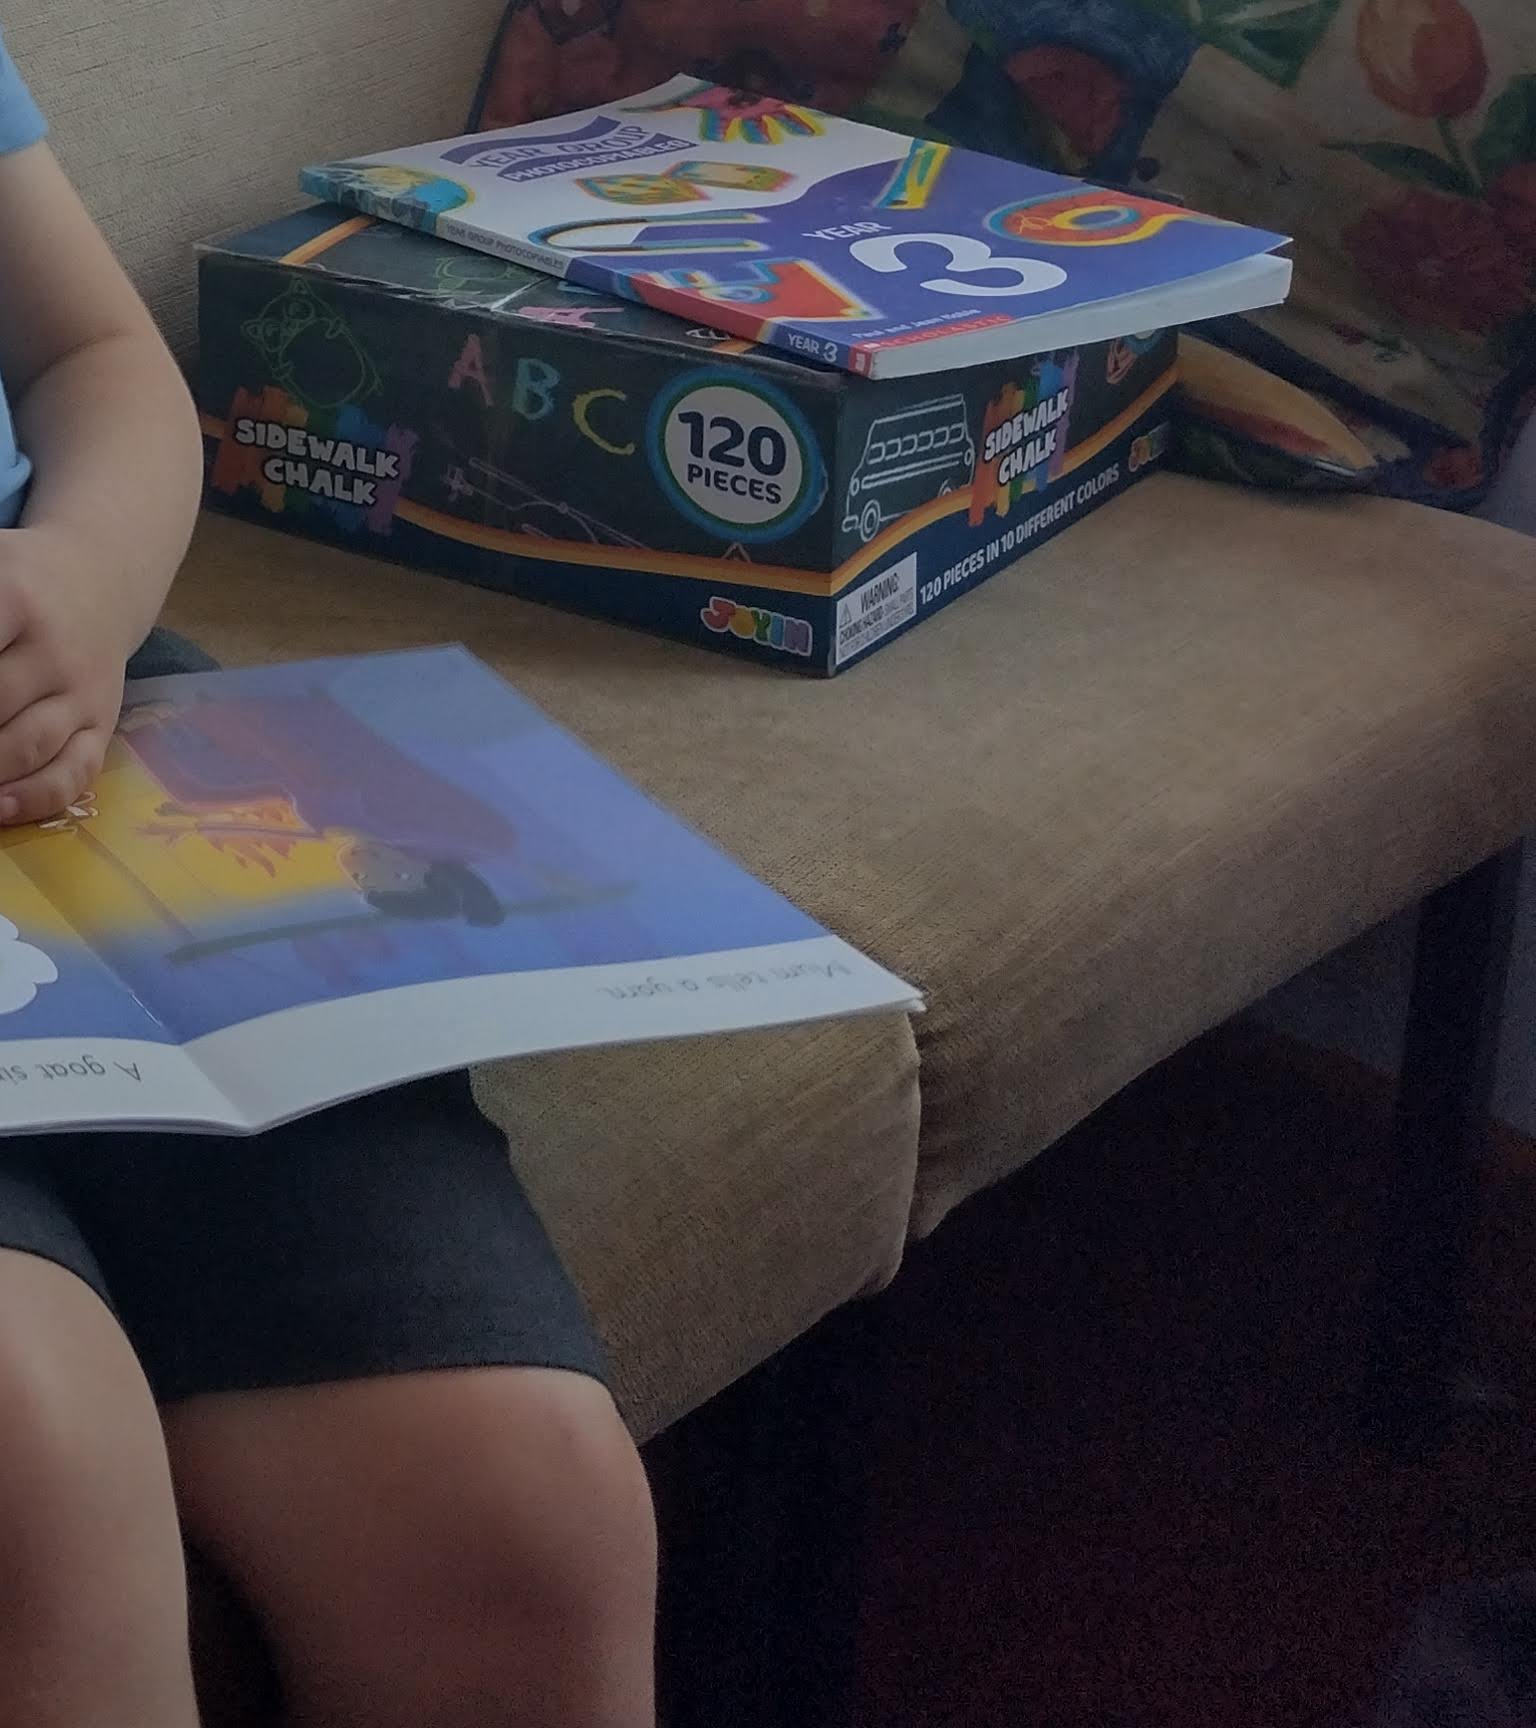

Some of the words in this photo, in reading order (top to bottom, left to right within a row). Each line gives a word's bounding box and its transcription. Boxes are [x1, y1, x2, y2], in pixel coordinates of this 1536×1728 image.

[469, 146, 544, 170] YEAR
[558, 125, 650, 154] GROUP
[503, 139, 691, 181] PHOTOCOPIABLES
[801, 220, 892, 242] YEAR
[849, 232, 1068, 297] 3
[786, 332, 820, 356] YEAR
[823, 341, 839, 364] 3
[879, 313, 1012, 347] SCHOLASTIC
[448, 333, 494, 409] A
[512, 357, 561, 422] B
[572, 387, 636, 456] C
[235, 417, 399, 480] SIDEWALK
[678, 410, 787, 477] 120
[984, 387, 1070, 461] SIDEWALK
[998, 429, 1057, 484] CHALK
[263, 457, 377, 507] CHALK
[687, 463, 782, 505] PIECES
[919, 575, 942, 605] 120
[943, 548, 985, 591] PIECES
[986, 539, 1000, 564] IN
[1001, 530, 1016, 553] 10
[1016, 490, 1076, 544] DIFFERENT
[1077, 462, 1120, 505] COLORS
[700, 596, 814, 657] JOYIN
[38, 1053, 107, 1082] goat
[113, 1060, 142, 1082] A
